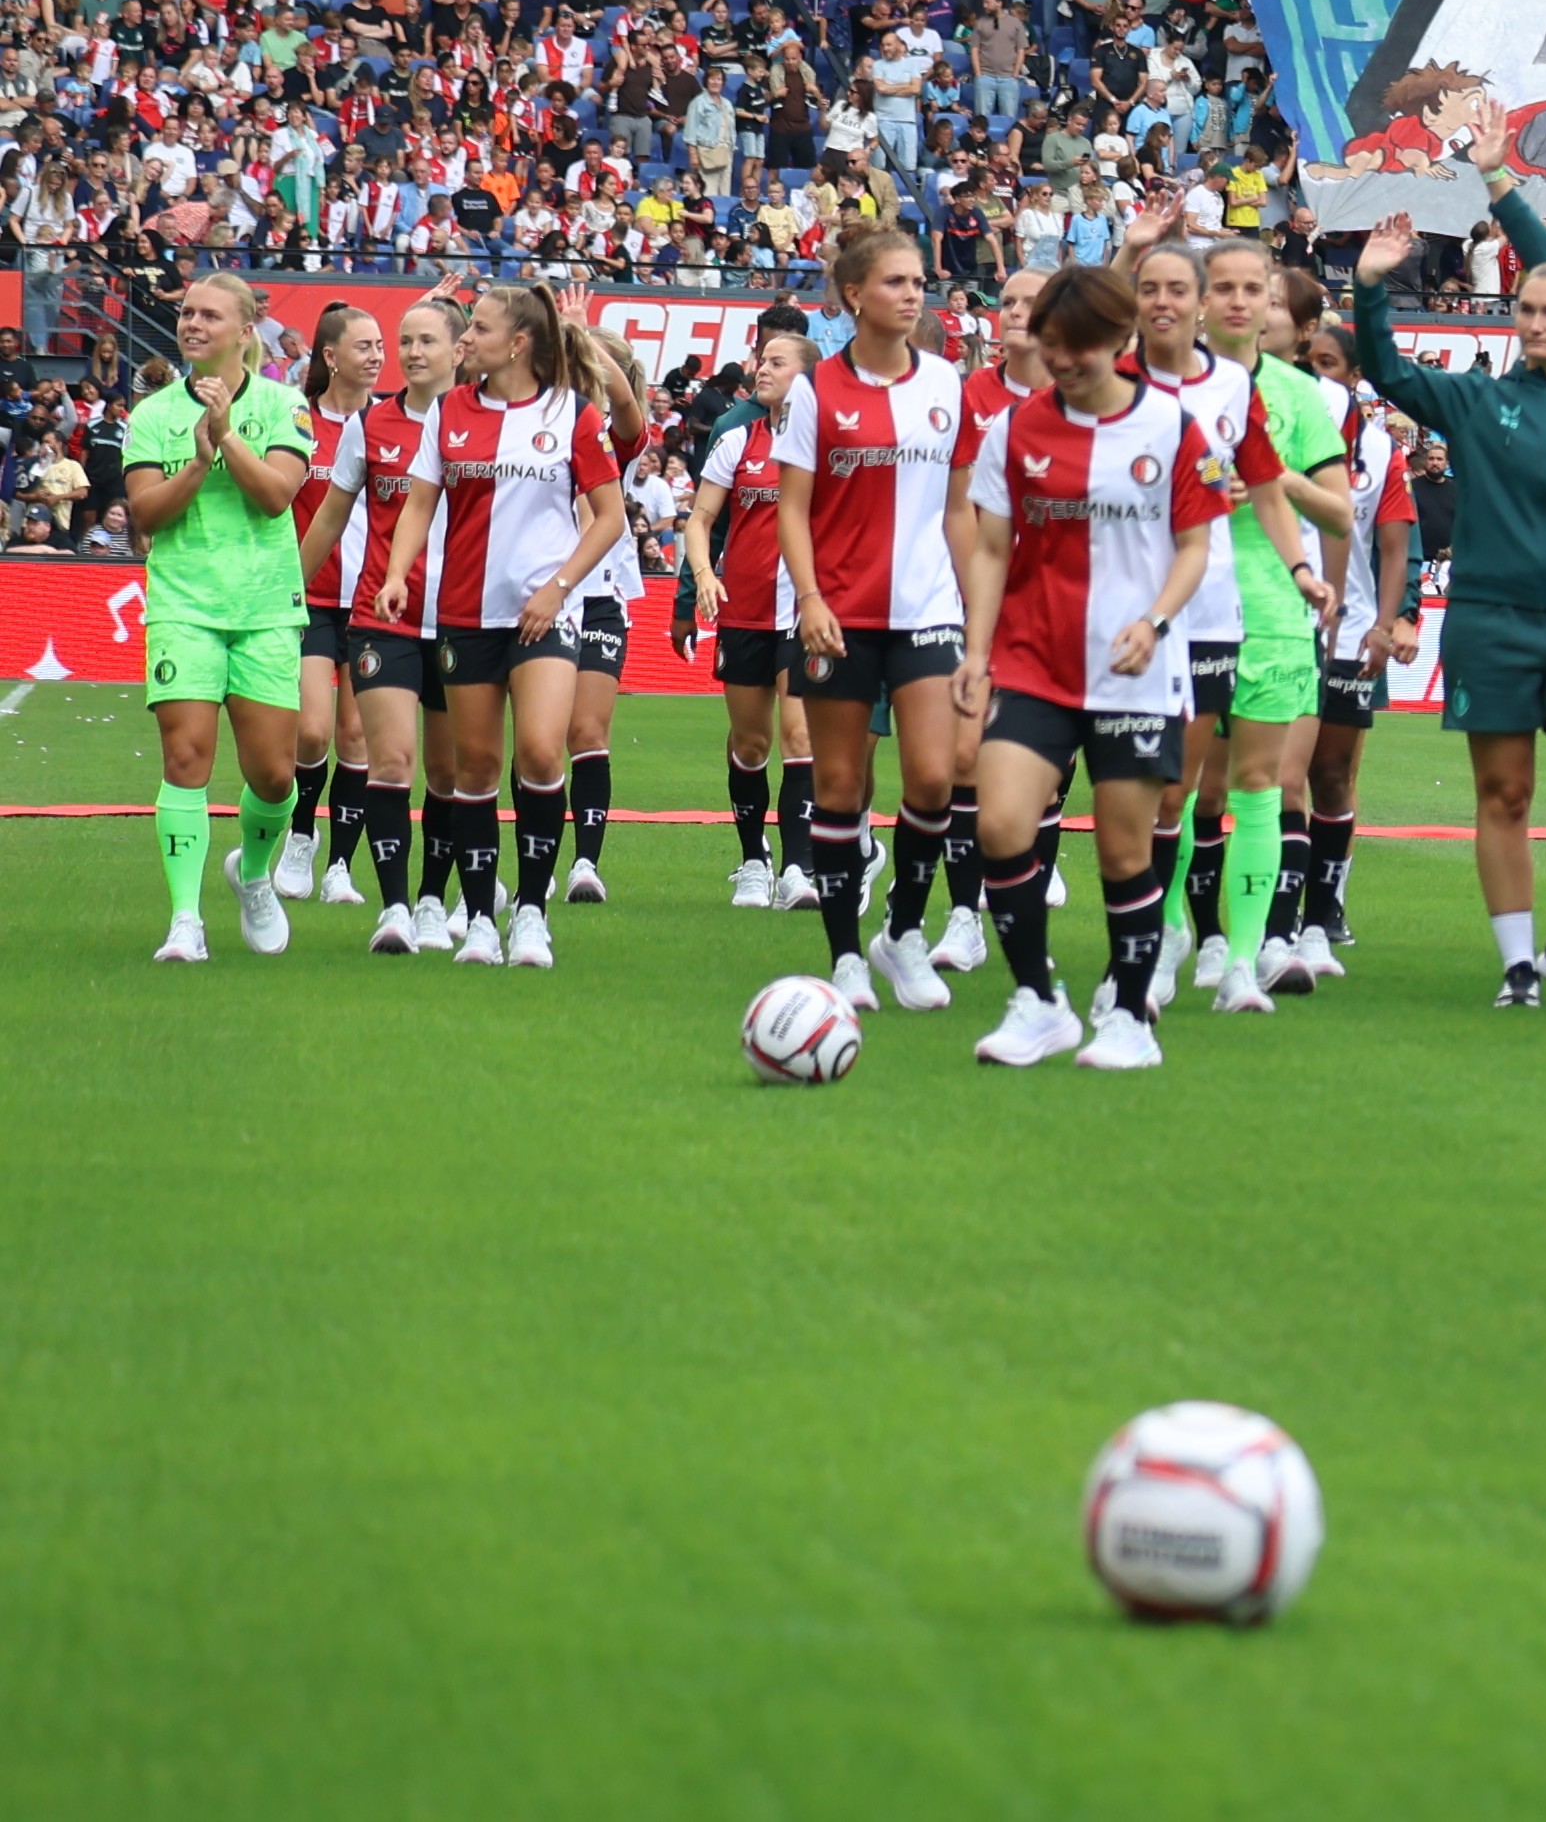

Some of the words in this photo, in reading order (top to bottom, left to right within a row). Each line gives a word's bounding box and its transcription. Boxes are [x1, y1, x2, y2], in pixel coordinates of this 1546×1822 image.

[1094, 715, 1167, 735] fairphone
[336, 805, 364, 826] F
[583, 809, 606, 826] F
[732, 804, 754, 820] F
[165, 834, 197, 856] F
[373, 839, 401, 862] F
[428, 837, 454, 859] F
[523, 834, 555, 859] F
[944, 838, 973, 863] F
[465, 847, 497, 871] F
[912, 859, 937, 882] F
[1188, 871, 1215, 894] F
[1278, 870, 1304, 893] F
[1320, 860, 1345, 883] F
[818, 872, 848, 896] F
[1240, 872, 1272, 895] F
[1120, 931, 1158, 963] F
